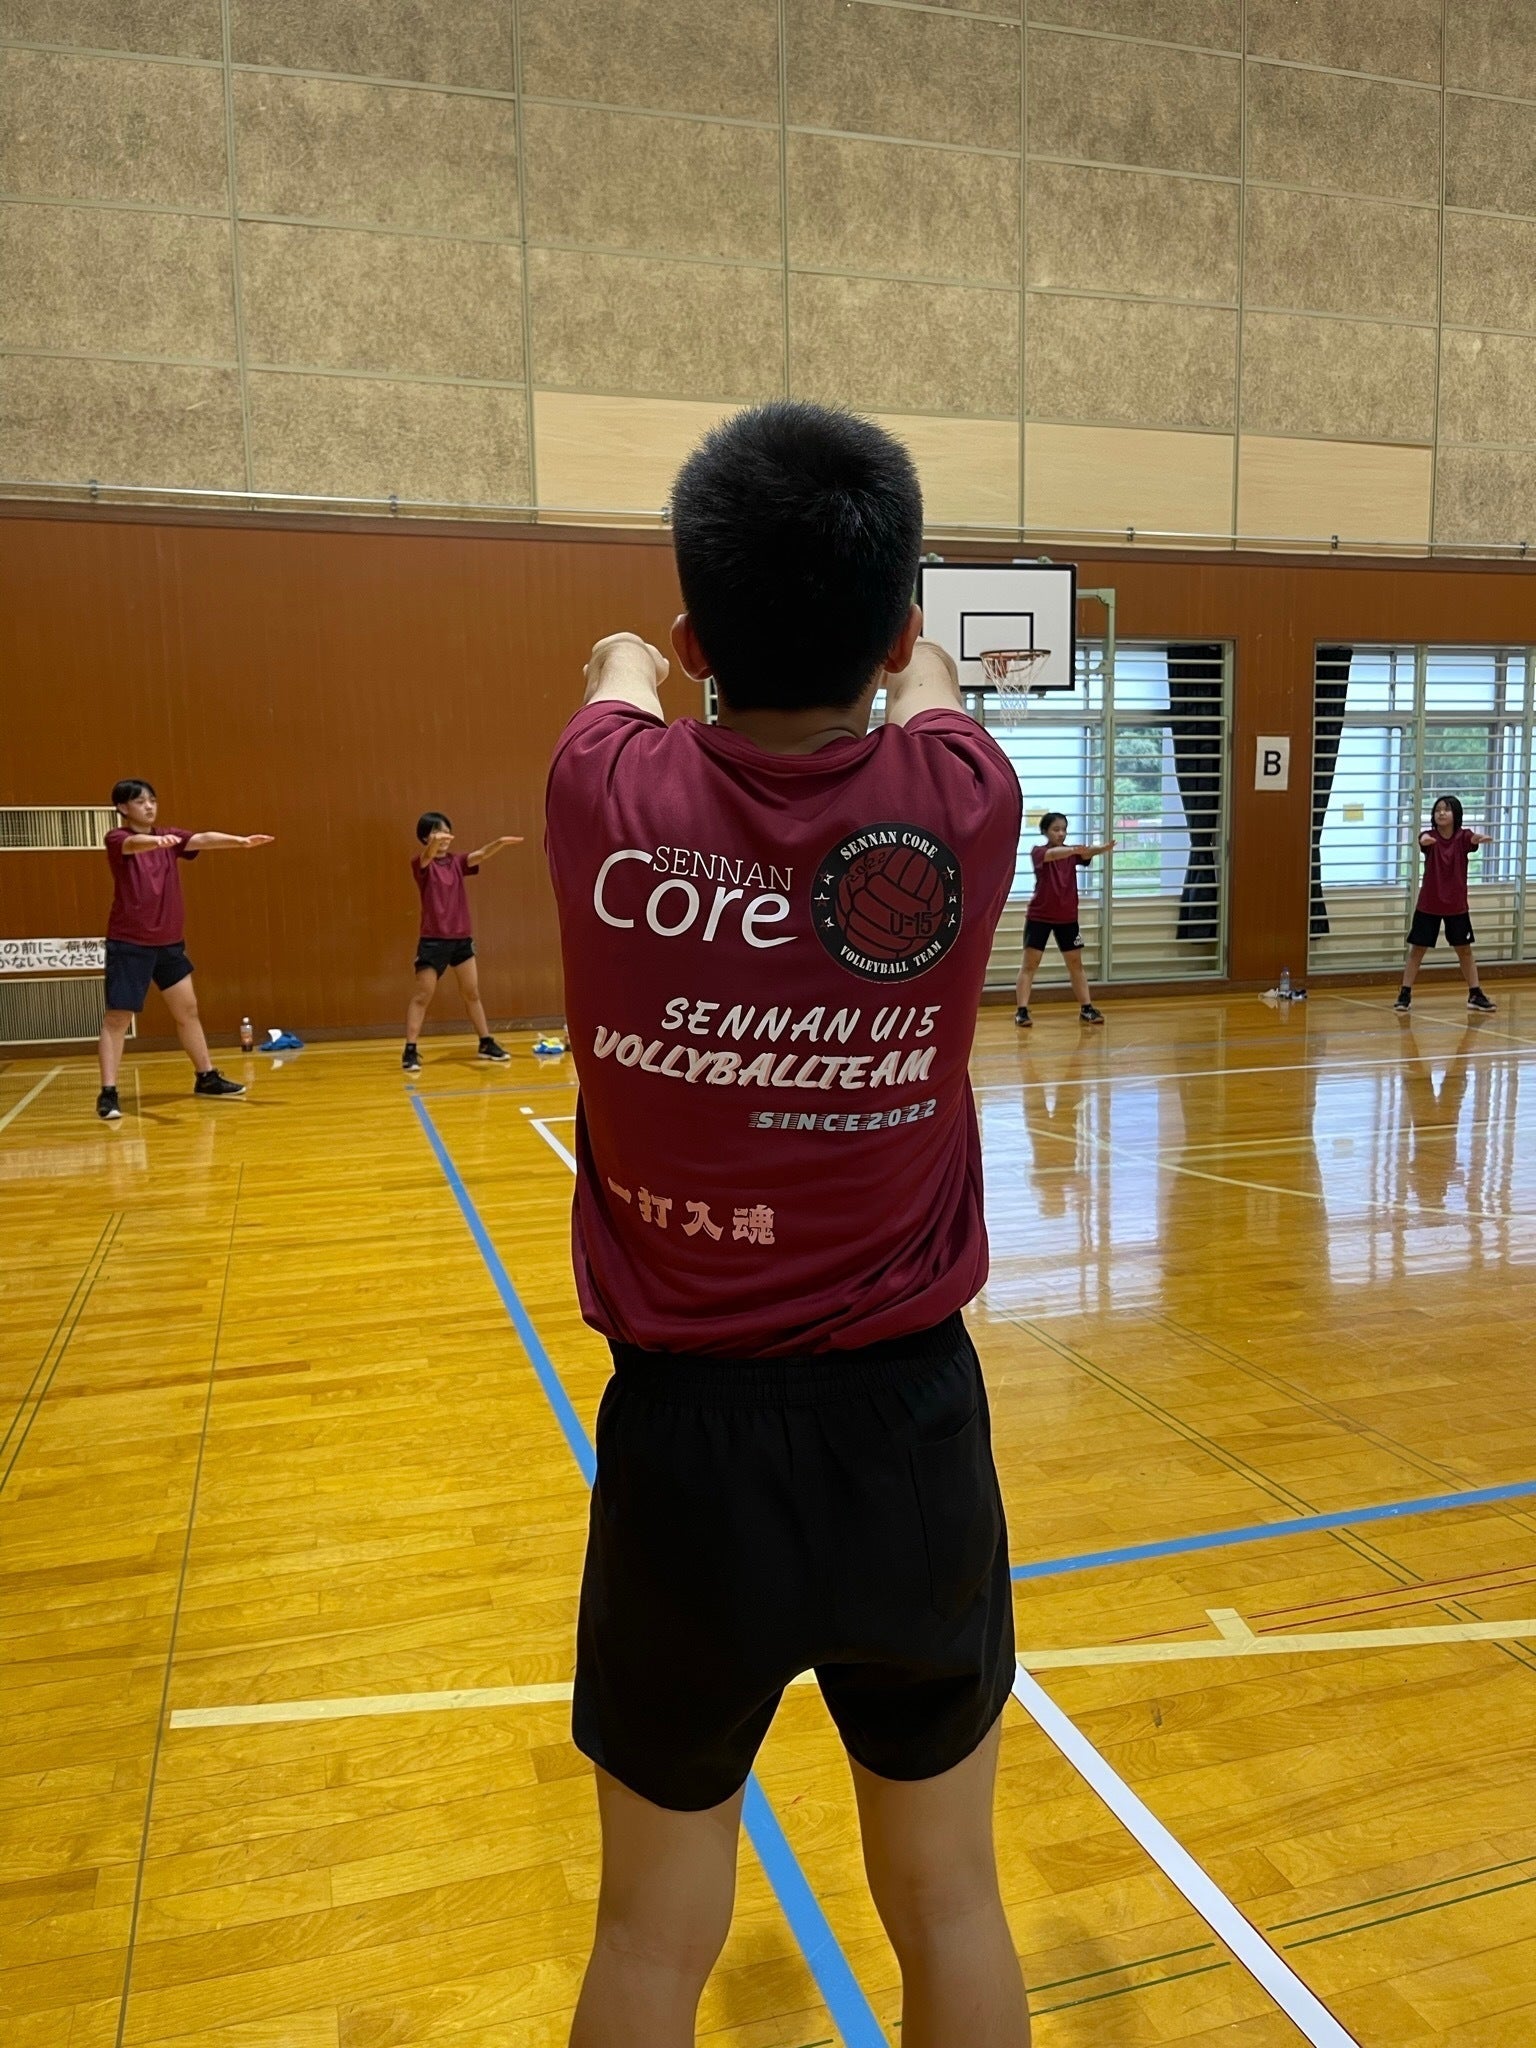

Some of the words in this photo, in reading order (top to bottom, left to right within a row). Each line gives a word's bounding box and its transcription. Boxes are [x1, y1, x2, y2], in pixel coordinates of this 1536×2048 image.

[1263, 750, 1281, 776] B
[840, 831, 897, 861] SENNAN
[902, 832, 938, 859] CORE
[653, 846, 793, 890] SENNAN
[594, 849, 798, 948] Core
[890, 911, 933, 936] U-15
[0, 941, 106, 954] の前に、荷物
[839, 945, 909, 974] VOLLEYBALL
[913, 940, 942, 967] TEAM
[661, 997, 861, 1044] SENNAN
[871, 1005, 942, 1042] U15
[607, 1176, 777, 1245] 一打入魂
